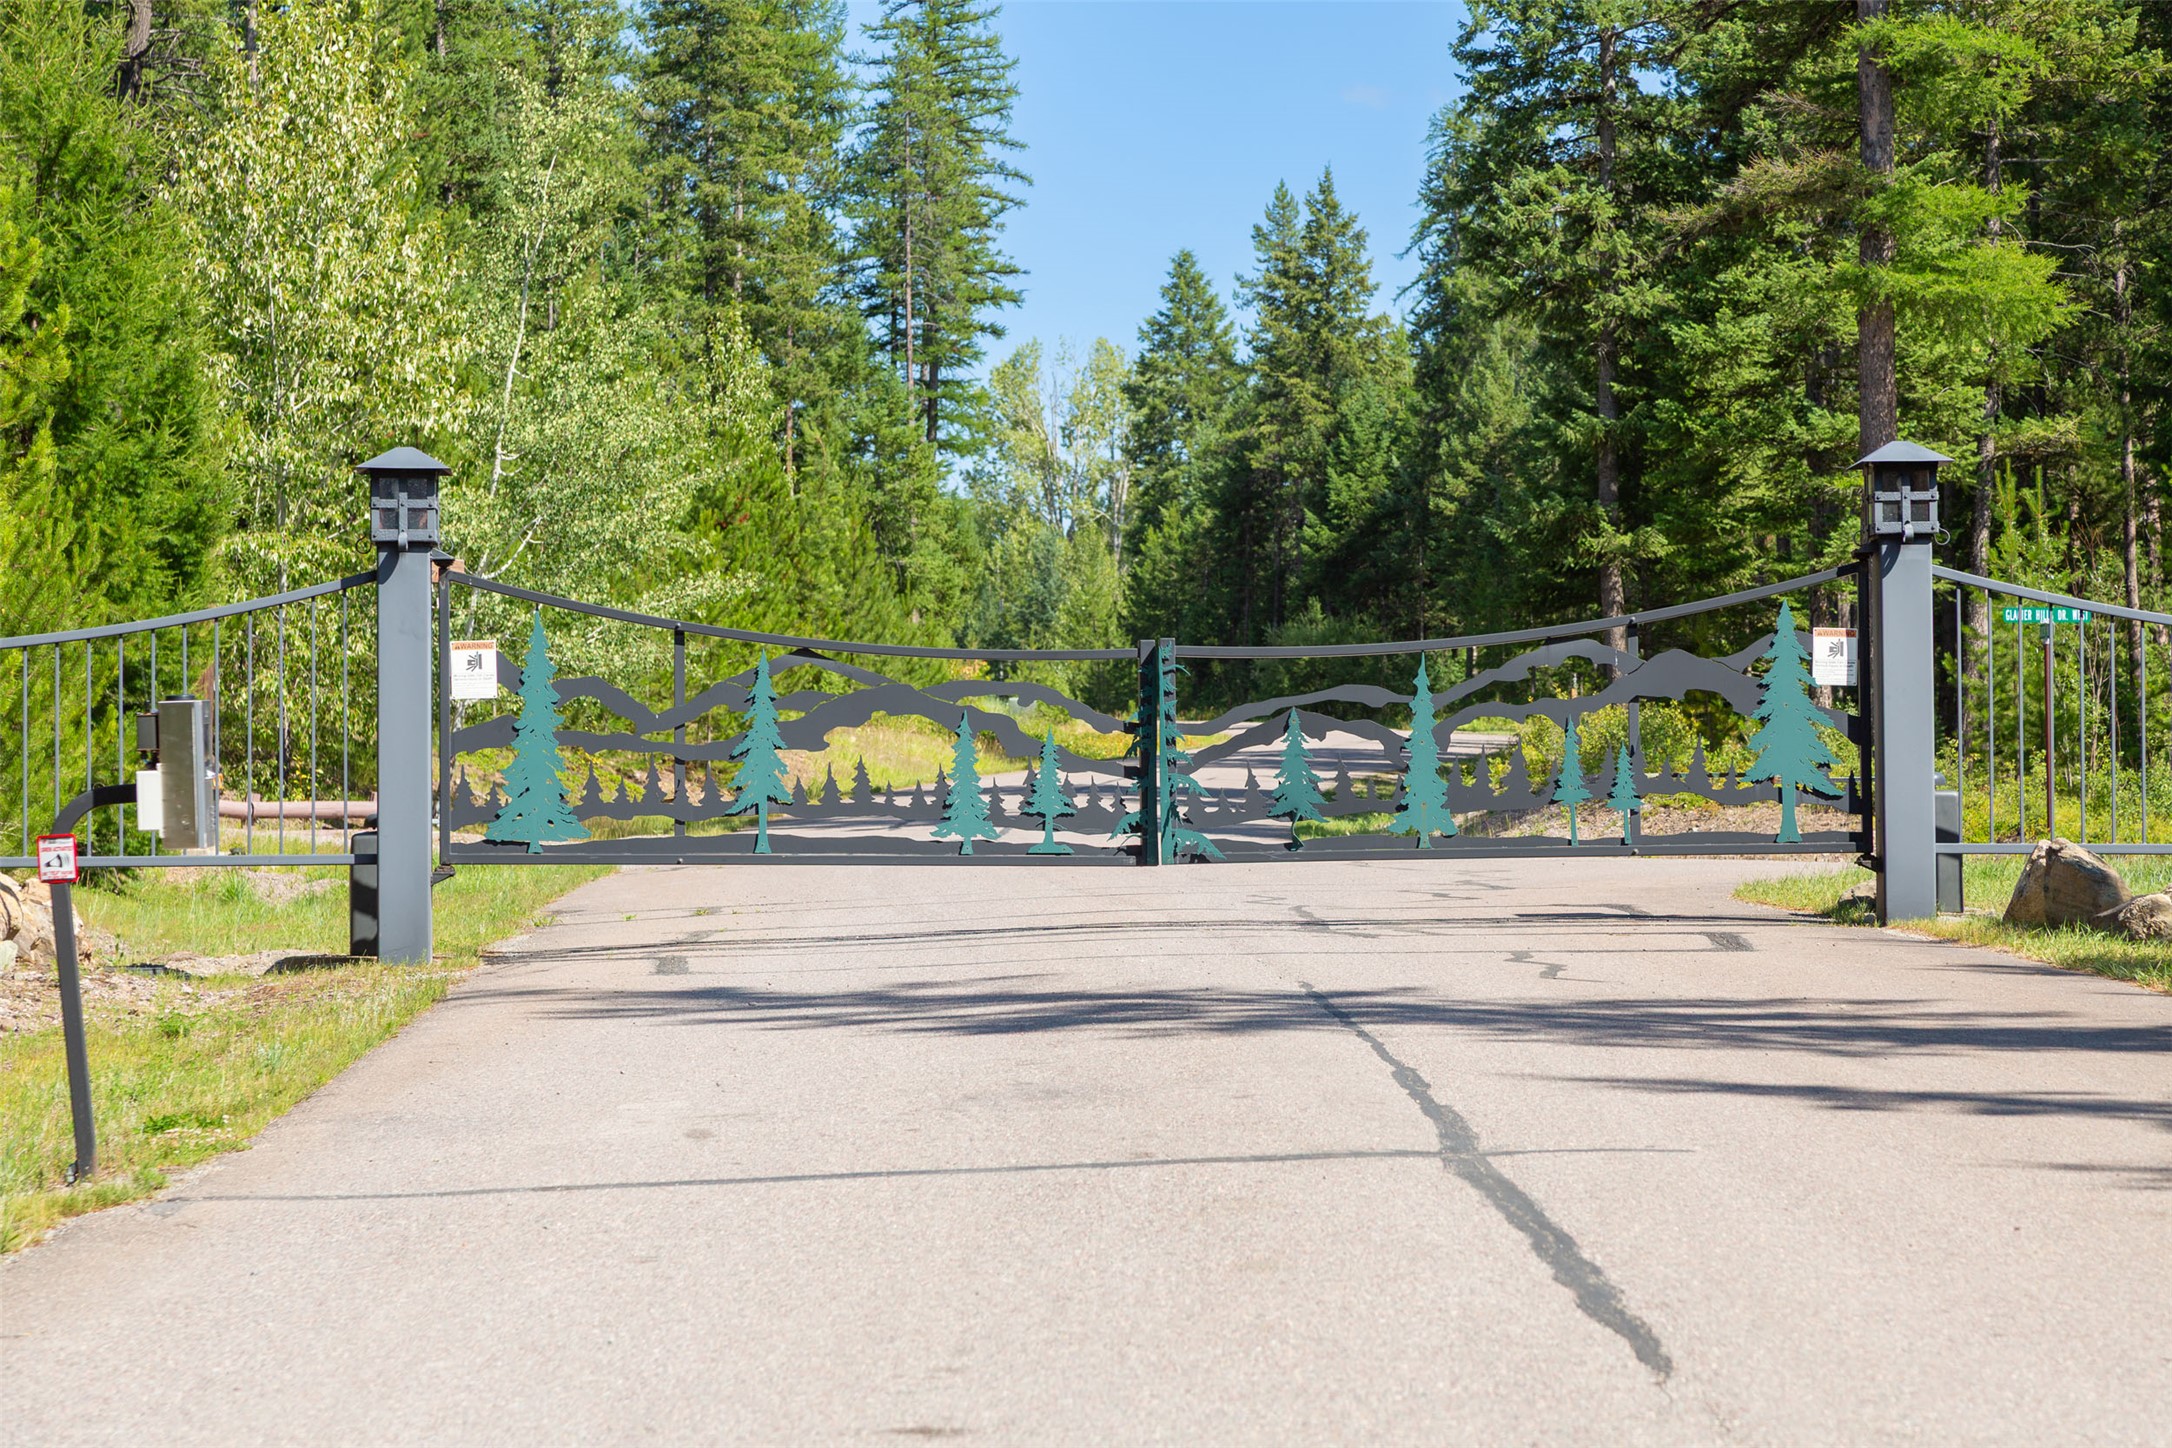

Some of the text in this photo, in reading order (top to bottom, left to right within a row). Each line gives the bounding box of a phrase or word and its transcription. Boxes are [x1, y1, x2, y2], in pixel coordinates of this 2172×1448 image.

[2005, 609, 2032, 621] GLAIER
[1822, 629, 1855, 637] WARNING
[460, 642, 493, 650] WARNING
